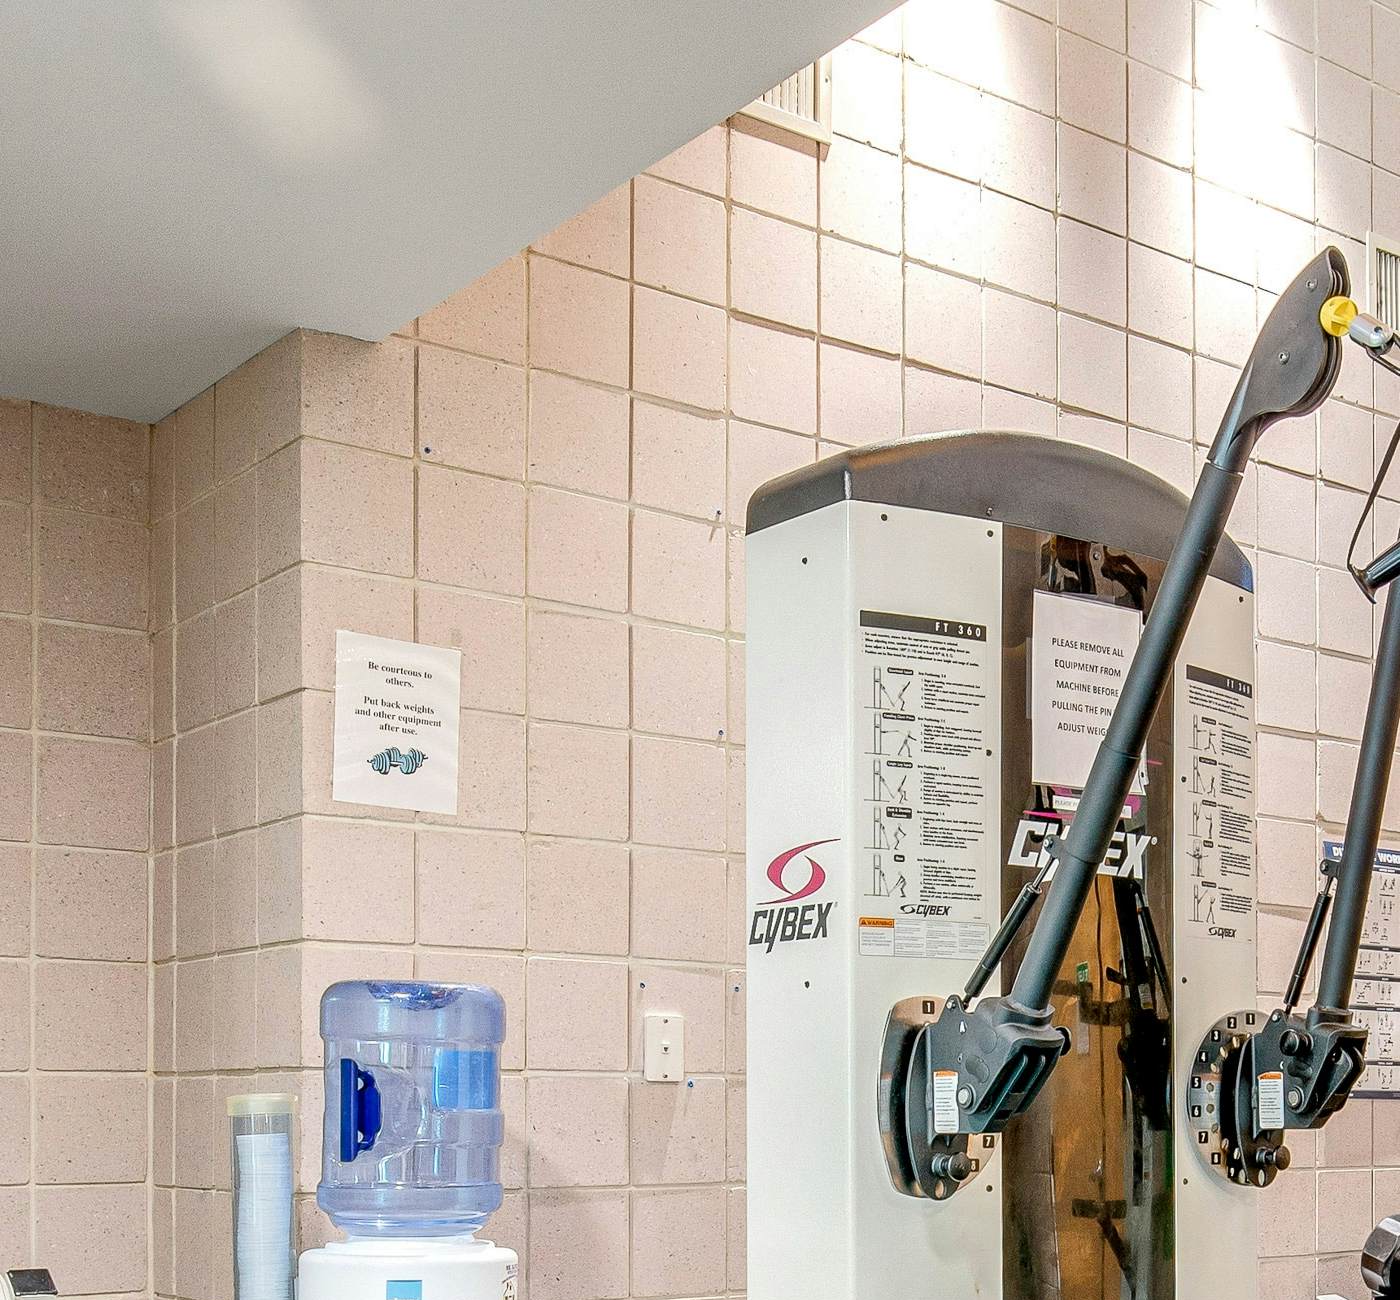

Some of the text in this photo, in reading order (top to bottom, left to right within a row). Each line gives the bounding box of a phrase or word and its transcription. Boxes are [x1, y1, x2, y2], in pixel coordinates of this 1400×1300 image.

[935, 622, 981, 638] FT 360
[1051, 638, 1124, 658] PLEASE REMOVE ALL
[368, 661, 432, 680] Be courteous to
[1054, 658, 1121, 677] EQUIPMENT FROM
[386, 677, 414, 688] others.
[1056, 680, 1119, 698] MACHINE BEFORE
[363, 696, 435, 715] Put back weights
[1051, 700, 1112, 717] PULLING THE PIN
[354, 708, 442, 728] and other equipment
[379, 722, 418, 736] after use.
[1057, 722, 1108, 736] ADJUST WEIG
[1008, 819, 1152, 882] CYEX
[916, 904, 951, 918] CYBEX
[749, 902, 834, 954] CYBEX
[926, 1002, 932, 1013] 1
[1230, 1018, 1235, 1028] 2
[1249, 1014, 1253, 1024] 1
[1214, 1031, 1219, 1040] 3
[1200, 1052, 1206, 1062] 4
[1194, 1078, 1199, 1088] 5
[1194, 1106, 1199, 1116] 6
[986, 1136, 992, 1147] 7
[1201, 1132, 1206, 1142] 7
[1214, 1154, 1218, 1164] 8
[1230, 1168, 1234, 1177] 9
